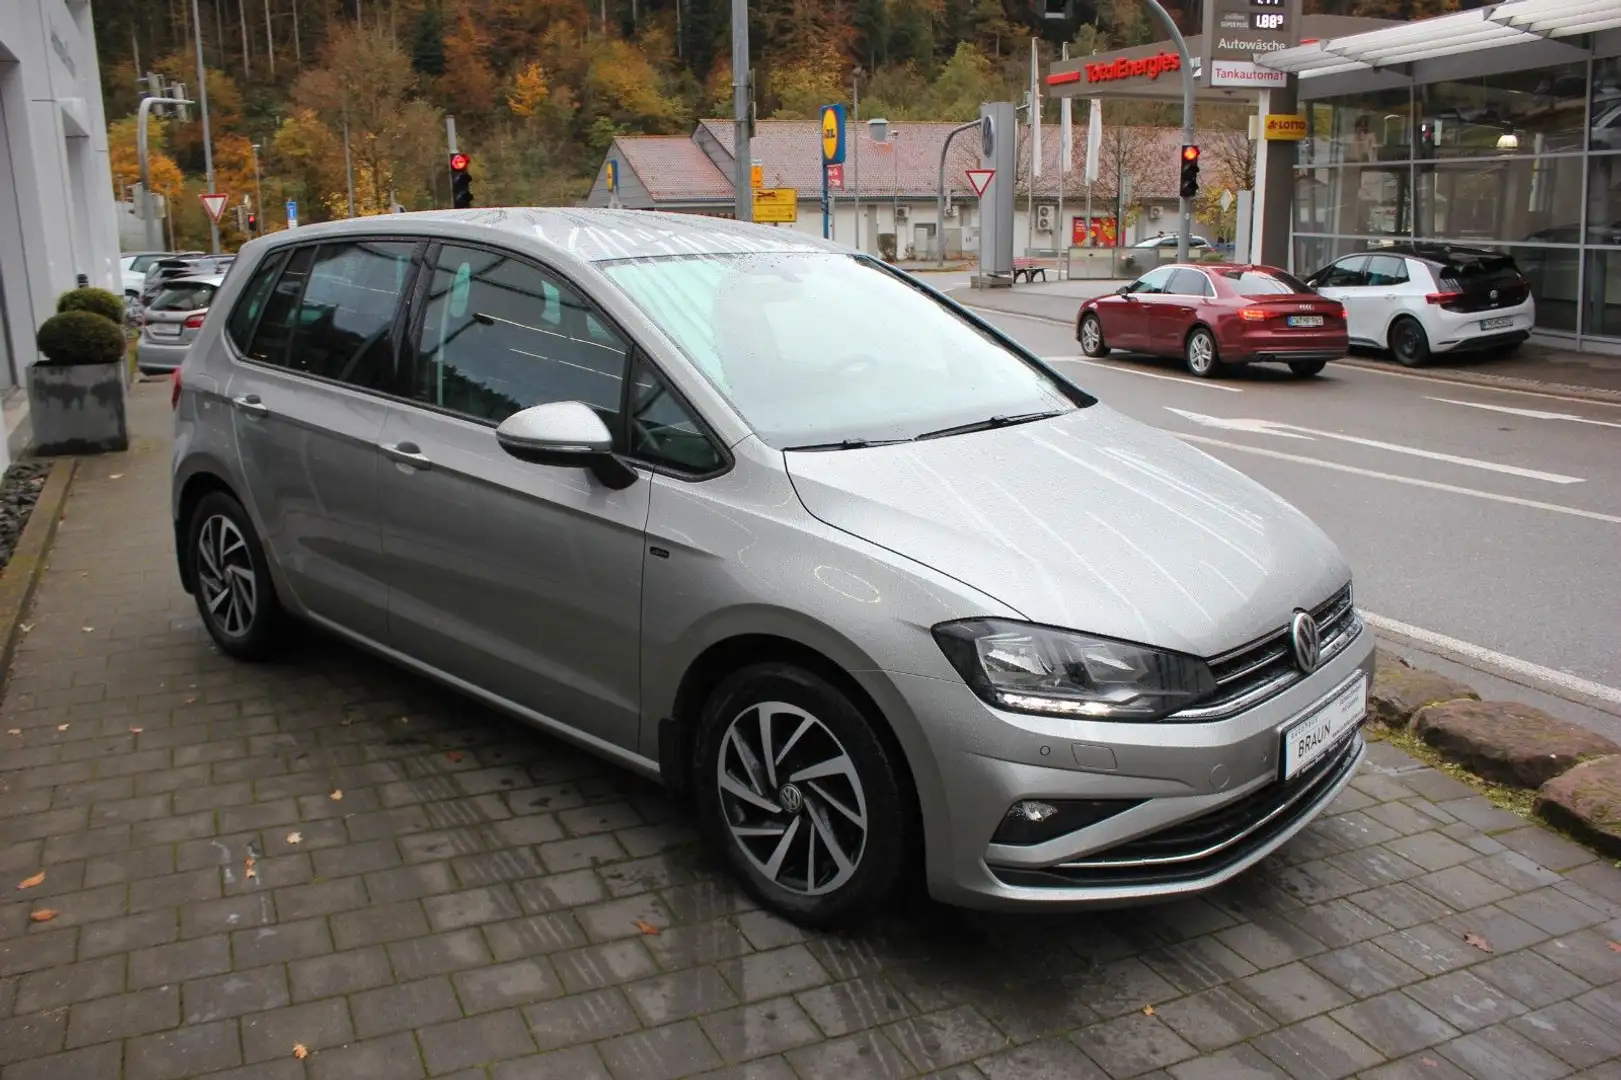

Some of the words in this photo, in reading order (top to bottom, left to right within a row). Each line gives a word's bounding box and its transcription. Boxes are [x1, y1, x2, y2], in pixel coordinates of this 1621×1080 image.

[1217, 38, 1286, 51] Autowäsche
[1084, 51, 1181, 82] TotalEnergies
[1215, 68, 1285, 81] Tankautomat
[1279, 120, 1305, 130] LOTTO
[1298, 720, 1332, 758] BRAUN
